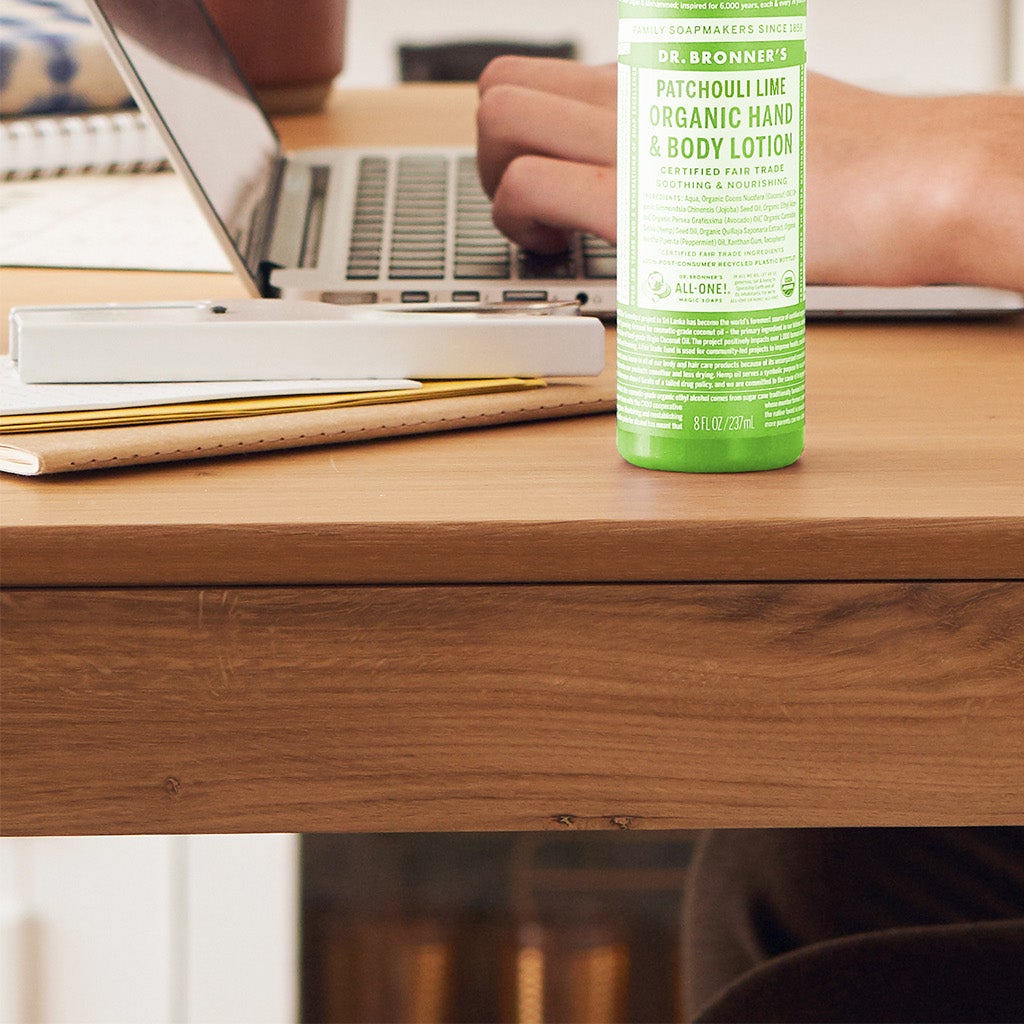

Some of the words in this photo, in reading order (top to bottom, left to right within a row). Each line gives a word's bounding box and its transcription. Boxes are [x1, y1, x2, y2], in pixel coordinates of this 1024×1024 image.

[680, 2, 706, 10] inspired
[633, 26, 665, 35] FAMILY
[669, 25, 754, 35] SOAPMAKERS
[758, 24, 786, 33] SINCE
[658, 50, 686, 64] DR.
[689, 48, 787, 65] BRONNER'S
[657, 80, 750, 98] PATCHOULI
[756, 77, 786, 97] LIME
[650, 105, 741, 129] ORGANIC
[748, 102, 793, 128] HAND
[649, 135, 661, 157] &
[668, 137, 724, 159] BODY
[730, 132, 792, 159] LOTION
[660, 167, 720, 176] CERTIFIED
[755, 164, 784, 174] TRADE
[656, 180, 711, 189] SOOTHING
[727, 177, 788, 189] NOURISHING
[702, 195, 724, 203] Organic
[744, 248, 784, 256] INGREDIENTS
[755, 257, 778, 265] PLASTIC
[675, 282, 727, 294] ALL-ONE!
[670, 317, 685, 325] Lanka
[740, 328, 760, 336] primary
[692, 337, 702, 345] The
[703, 338, 723, 346] project
[714, 361, 739, 369] products
[716, 371, 733, 379] Hemp
[681, 380, 694, 388] drug
[690, 394, 710, 402] alcohol
[743, 394, 756, 402] sugar
[694, 416, 700, 430] 8
[701, 416, 710, 430] FL
